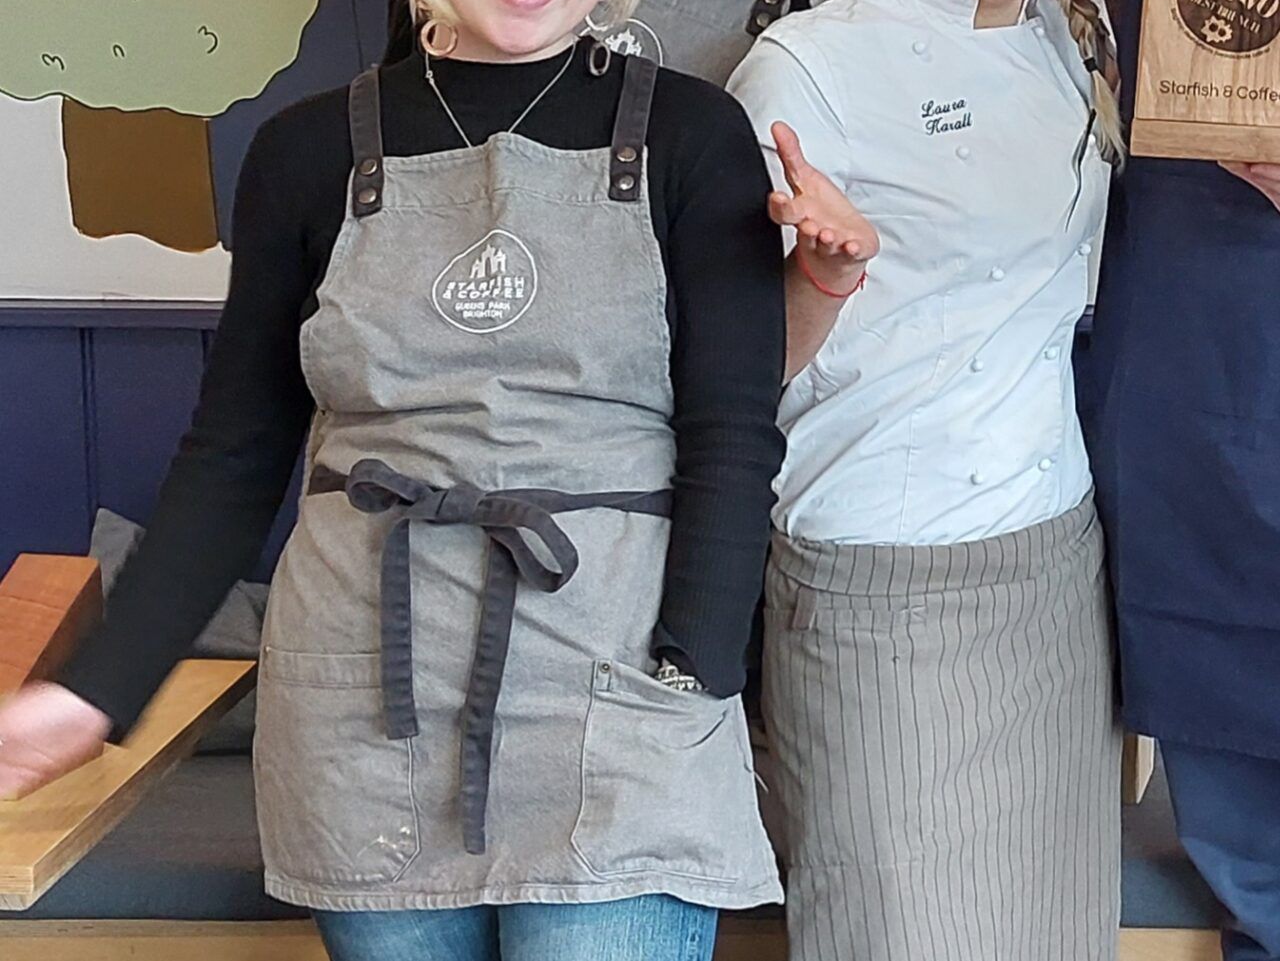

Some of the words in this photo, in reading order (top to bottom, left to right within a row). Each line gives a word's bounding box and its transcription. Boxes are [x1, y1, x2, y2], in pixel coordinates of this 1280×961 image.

[1159, 79, 1219, 98] Starfish
[1223, 85, 1233, 98] &
[921, 99, 965, 118] Laura
[447, 275, 525, 291] STARFISH
[457, 288, 525, 299] COFFEE
[488, 301, 510, 311] PARK
[462, 309, 503, 319] BRIGHTON
